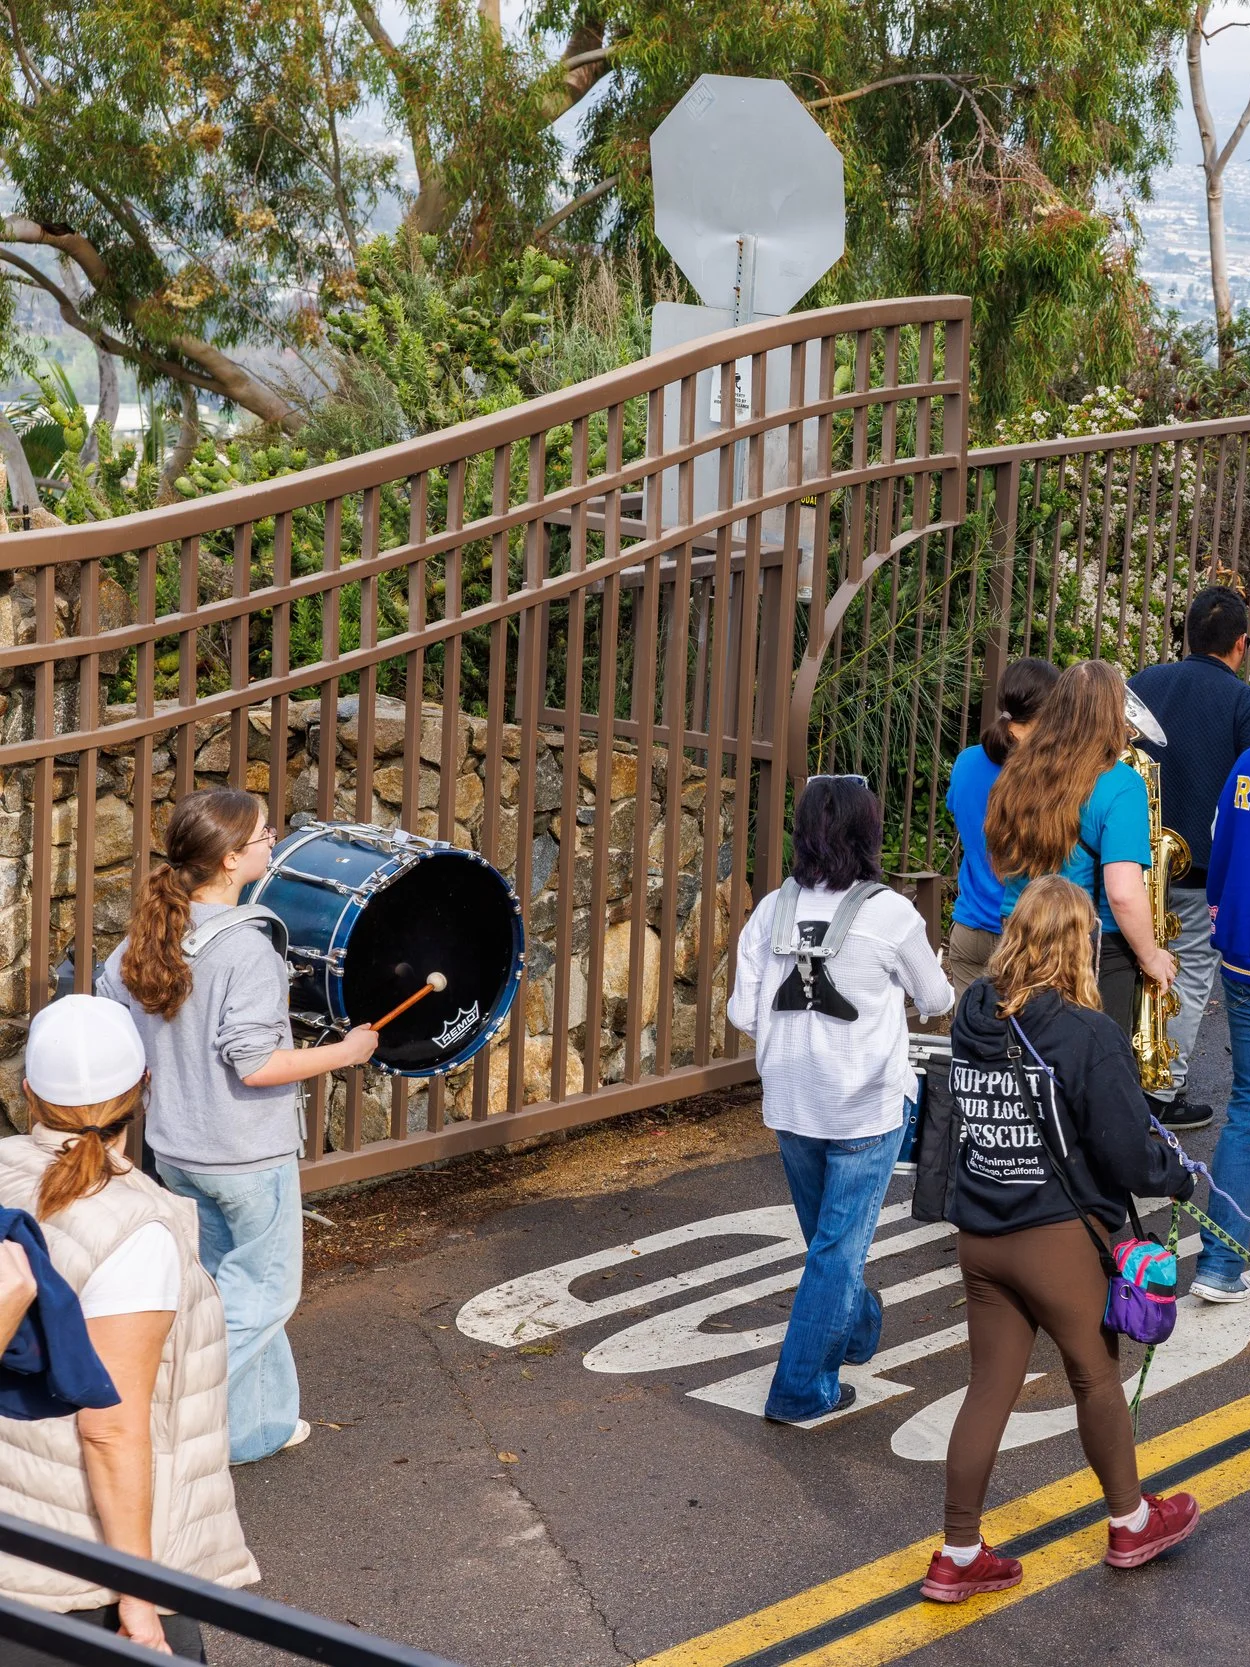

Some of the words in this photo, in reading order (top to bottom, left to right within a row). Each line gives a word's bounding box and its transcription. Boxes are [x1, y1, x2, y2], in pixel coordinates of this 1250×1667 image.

[441, 1012, 477, 1045] REMO
[956, 1096, 989, 1118] OUR
[992, 1100, 1046, 1120] LOCL
[960, 1121, 1043, 1149] ESCUE
[971, 1149, 984, 1162] The
[984, 1156, 1016, 1167] Animal
[1017, 1156, 1039, 1166] Pad
[978, 1163, 1003, 1177] Diego,
[1003, 1166, 1045, 1177] California
